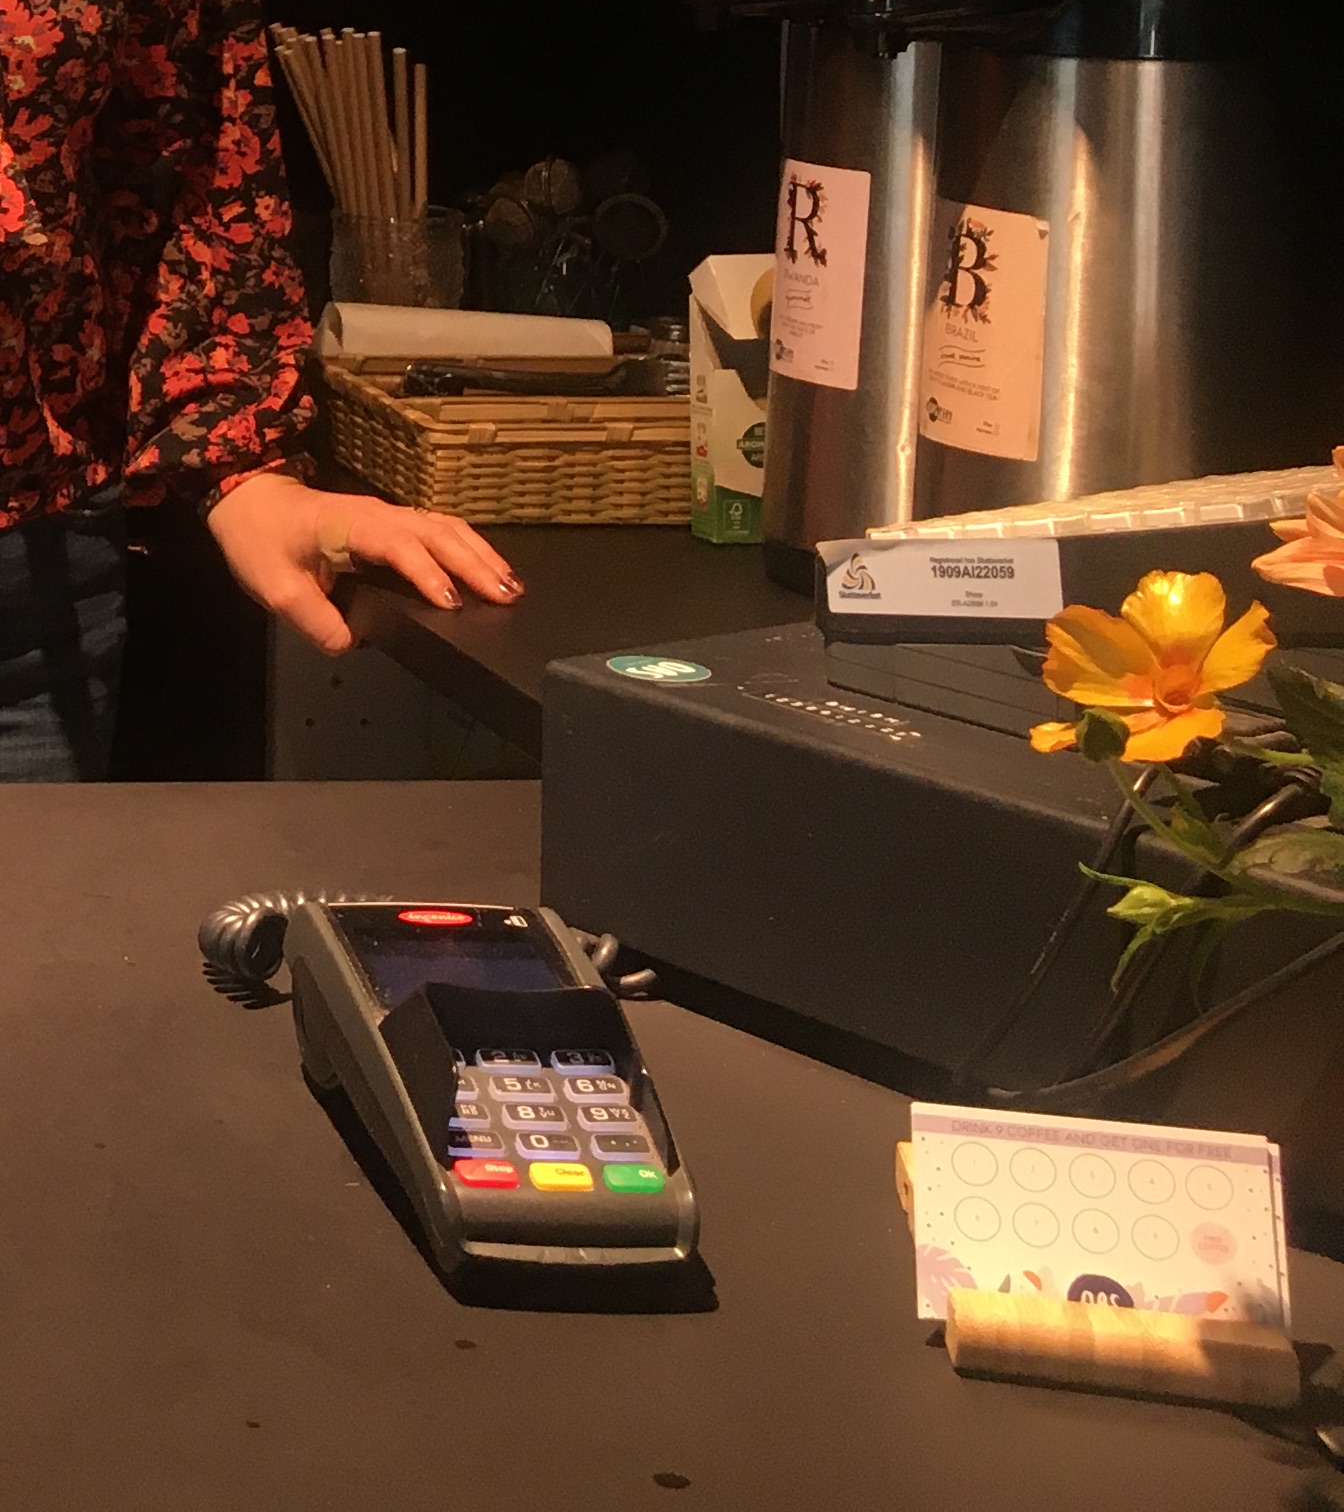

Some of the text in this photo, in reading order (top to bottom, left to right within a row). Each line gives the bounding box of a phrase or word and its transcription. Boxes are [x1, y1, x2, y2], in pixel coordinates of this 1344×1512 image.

[945, 322, 979, 343] BRAZIL
[503, 1077, 522, 1091] 5
[576, 1079, 595, 1093] 6
[516, 1105, 536, 1119] 8
[590, 1106, 609, 1120] 9
[951, 1119, 993, 1134] DRINK
[1007, 1125, 1061, 1142] COFFEE
[1065, 1131, 1096, 1145] AND
[1102, 1135, 1128, 1149] GET
[1133, 1138, 1163, 1153] ONE
[1167, 1141, 1197, 1155] FOR
[1198, 1144, 1232, 1159] FREE
